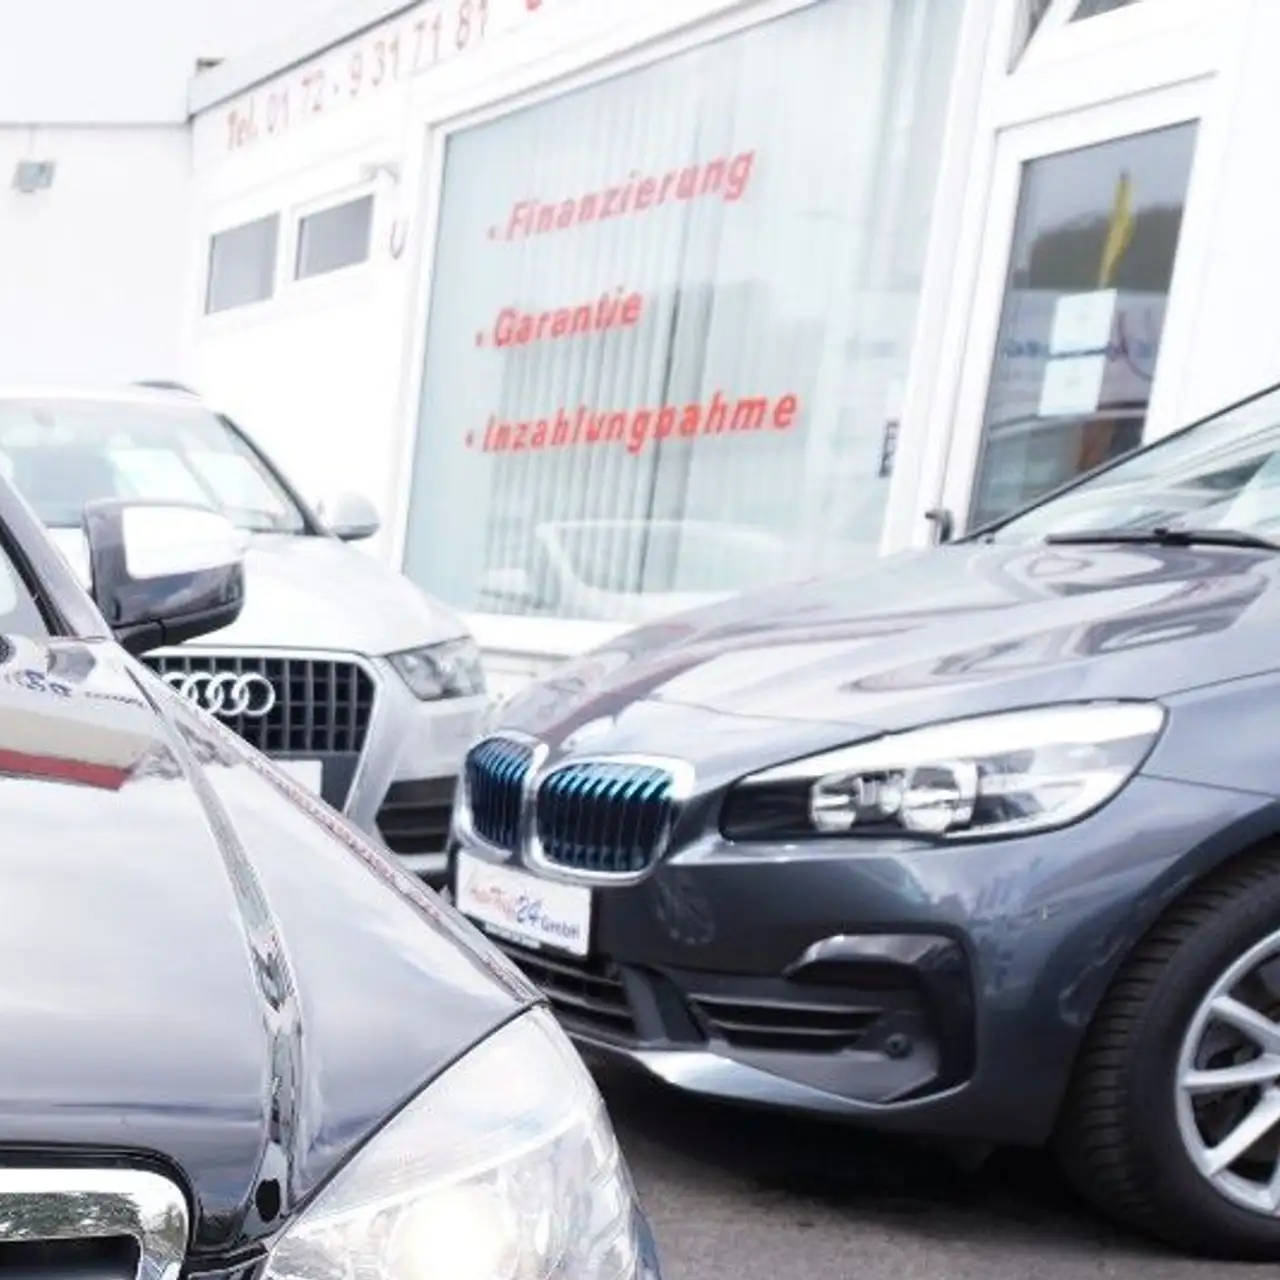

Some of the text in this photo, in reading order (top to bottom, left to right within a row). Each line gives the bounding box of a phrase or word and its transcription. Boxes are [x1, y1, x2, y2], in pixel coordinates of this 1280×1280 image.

[505, 149, 756, 242] Finanzierung
[493, 284, 646, 349] Garantie
[482, 391, 800, 457] Inzahlungnahme
